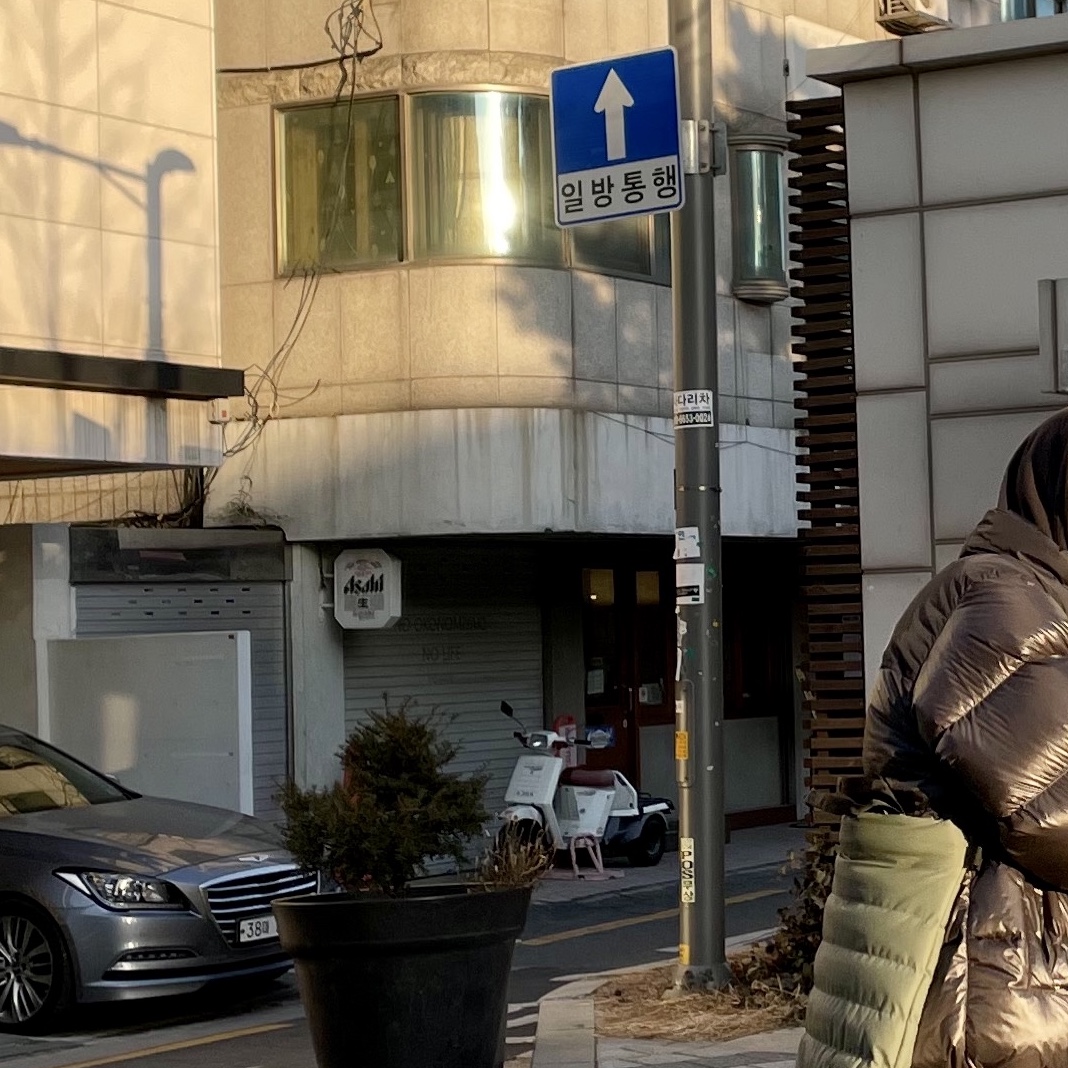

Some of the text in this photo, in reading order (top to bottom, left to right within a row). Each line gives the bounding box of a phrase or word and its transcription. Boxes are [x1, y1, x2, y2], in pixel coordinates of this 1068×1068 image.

[561, 164, 677, 214] 일방통행
[676, 393, 710, 406] 다리차
[343, 573, 384, 595] Asahi
